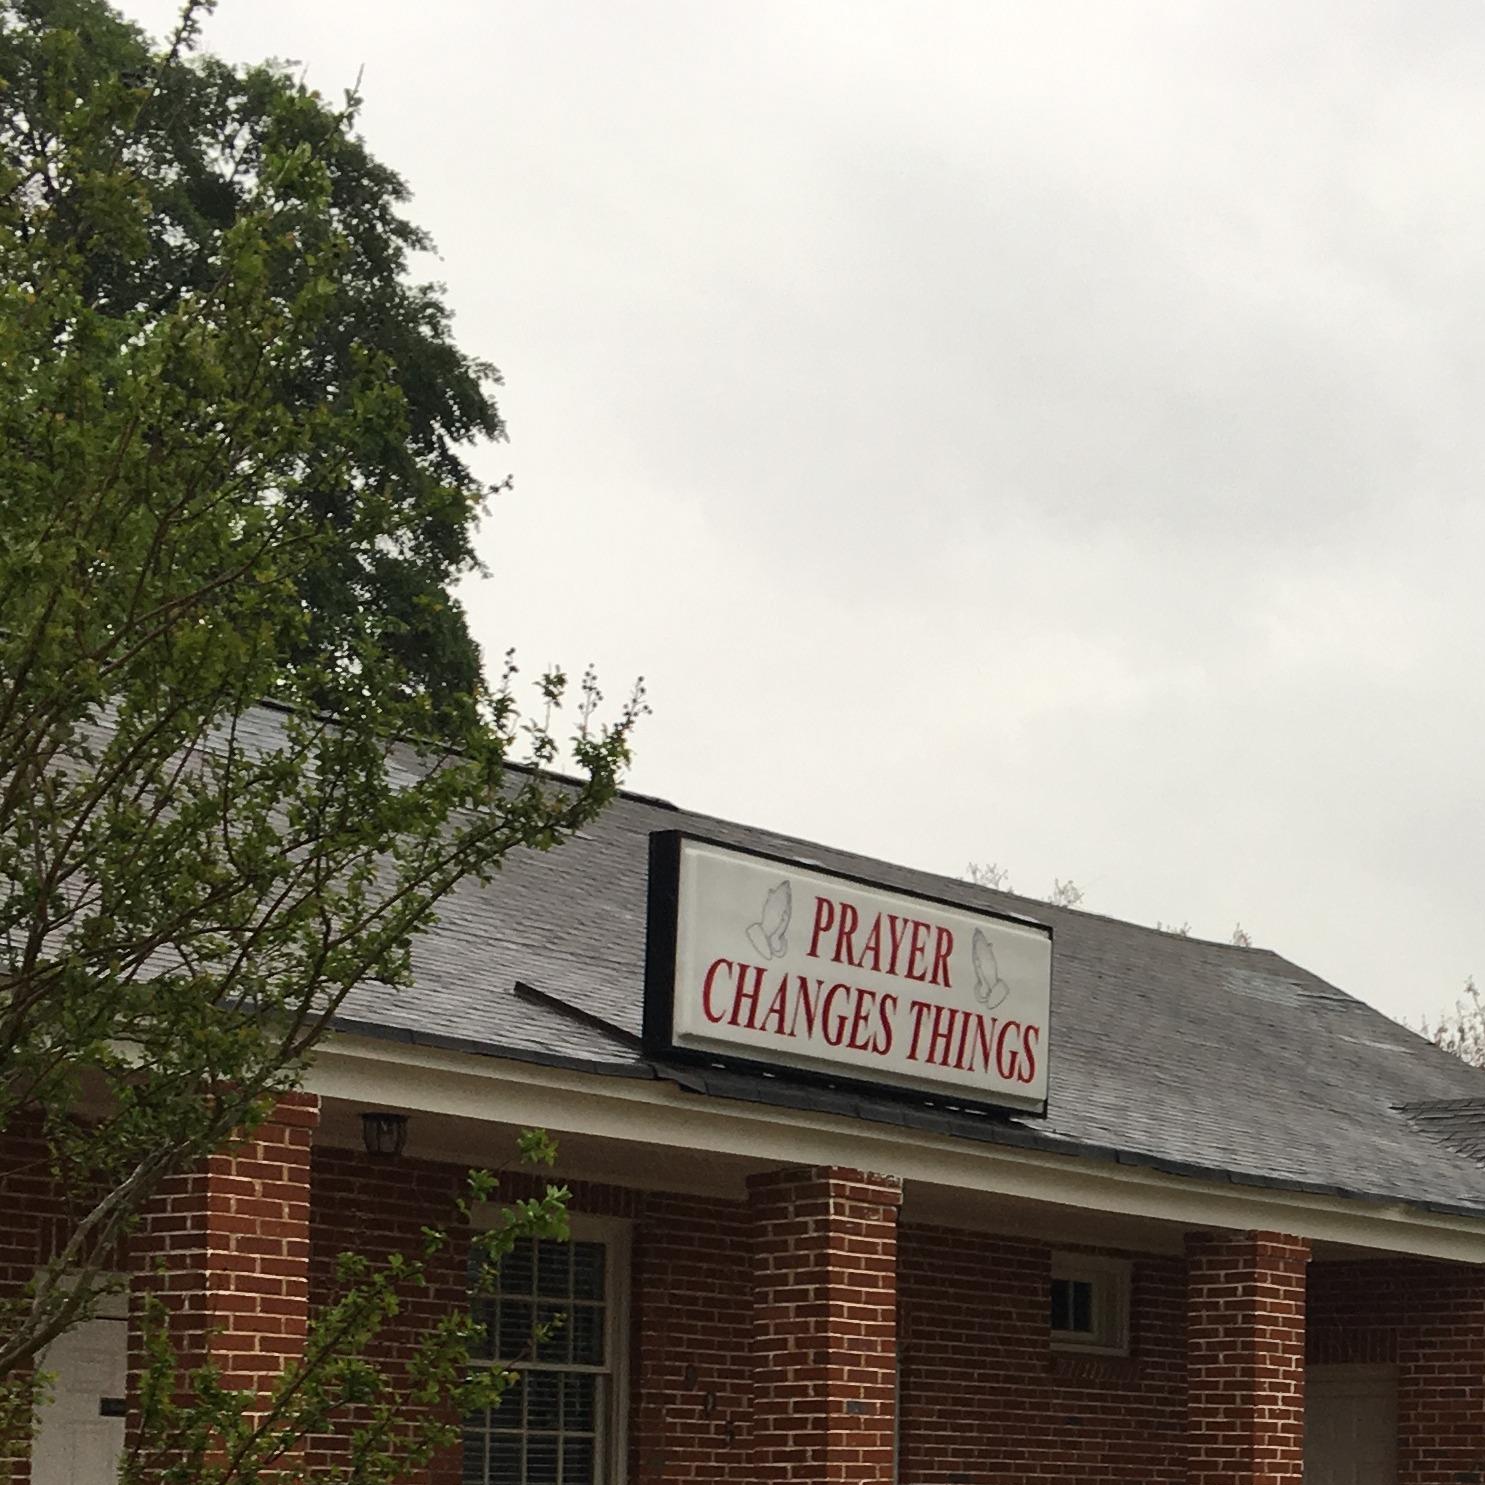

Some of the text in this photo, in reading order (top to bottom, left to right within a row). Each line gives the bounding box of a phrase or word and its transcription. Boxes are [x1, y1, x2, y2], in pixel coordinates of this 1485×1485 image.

[807, 896, 954, 988] PRAYER
[702, 958, 1040, 1084] CHANGES THINGS
